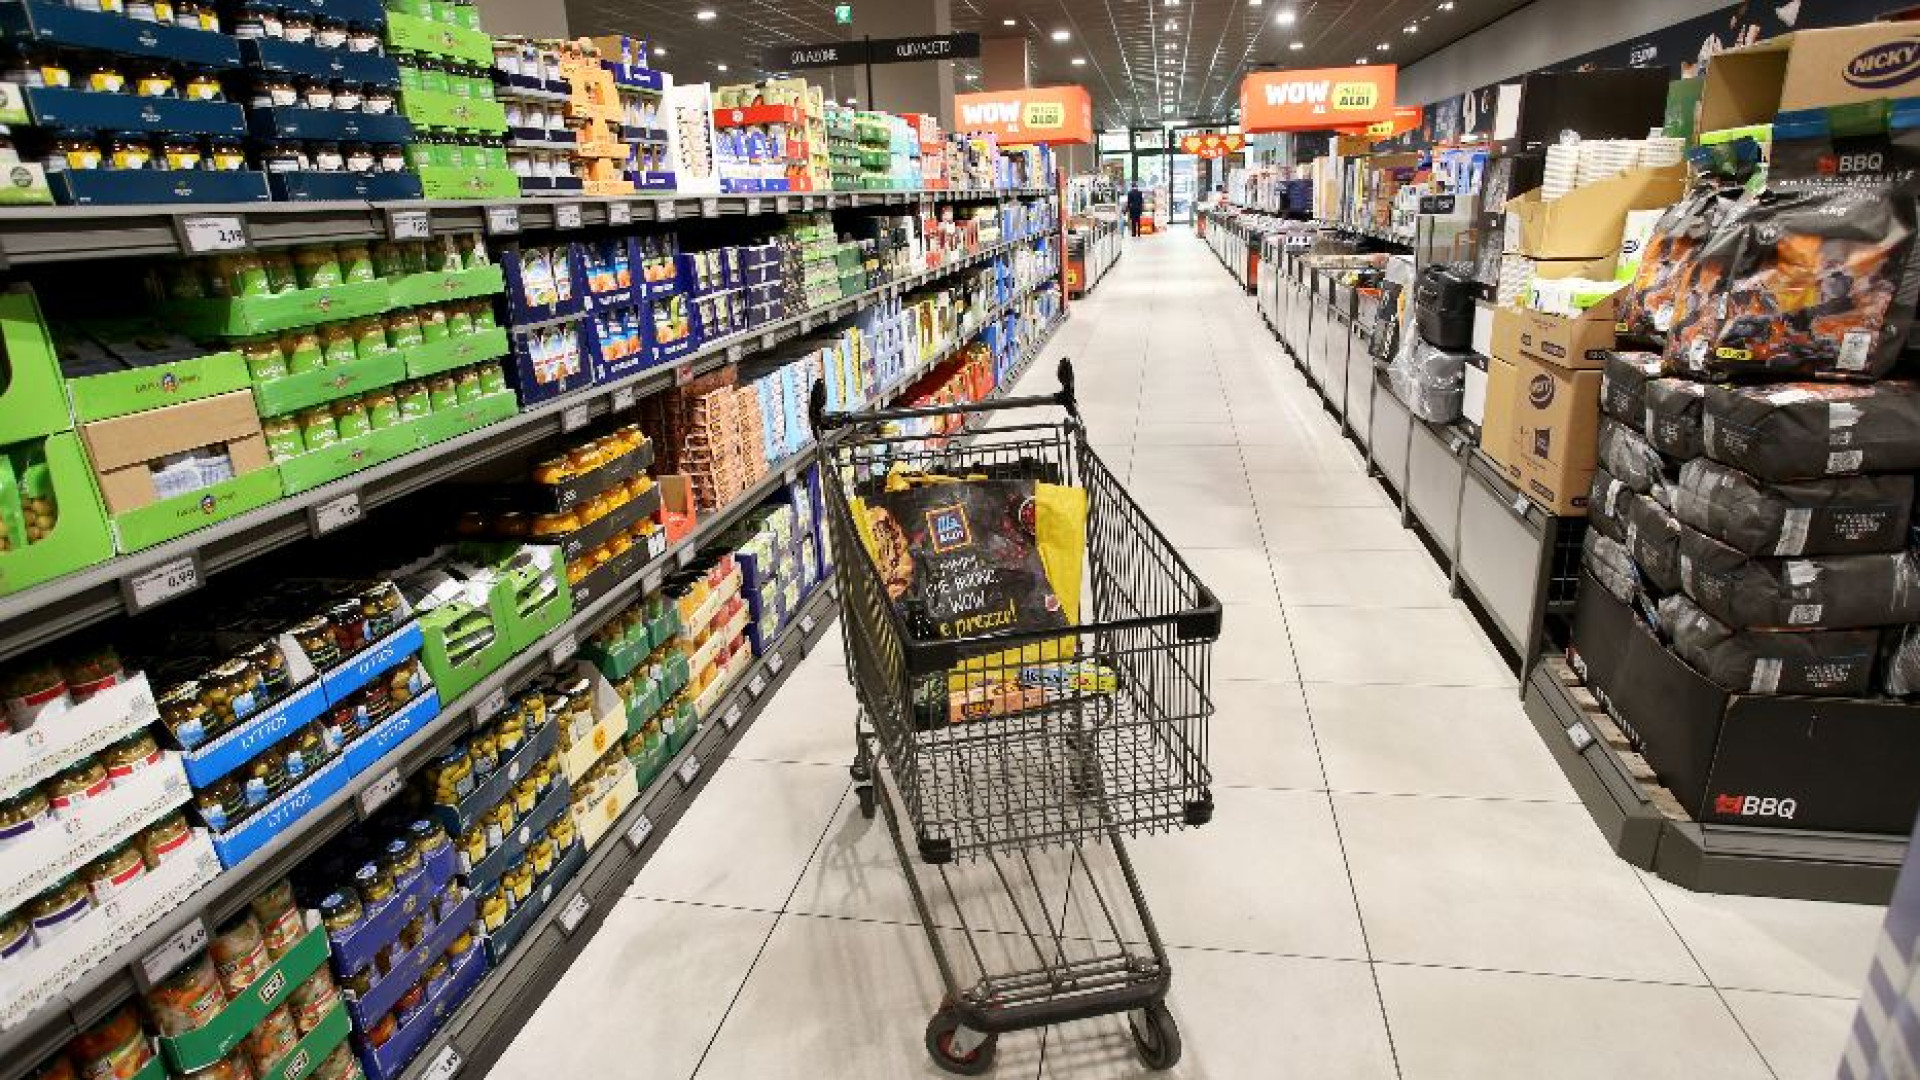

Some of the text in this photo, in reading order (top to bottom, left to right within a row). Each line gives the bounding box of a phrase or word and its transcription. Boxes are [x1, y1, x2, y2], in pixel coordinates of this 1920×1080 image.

[1853, 47, 1914, 75] NICKY
[1264, 80, 1330, 106] WOW
[962, 100, 1020, 125] WOW
[1840, 153, 1883, 172] BBQ
[242, 713, 288, 749] LYTTOS
[267, 789, 312, 828] LYTTOS
[1741, 796, 1798, 820] BBQ
